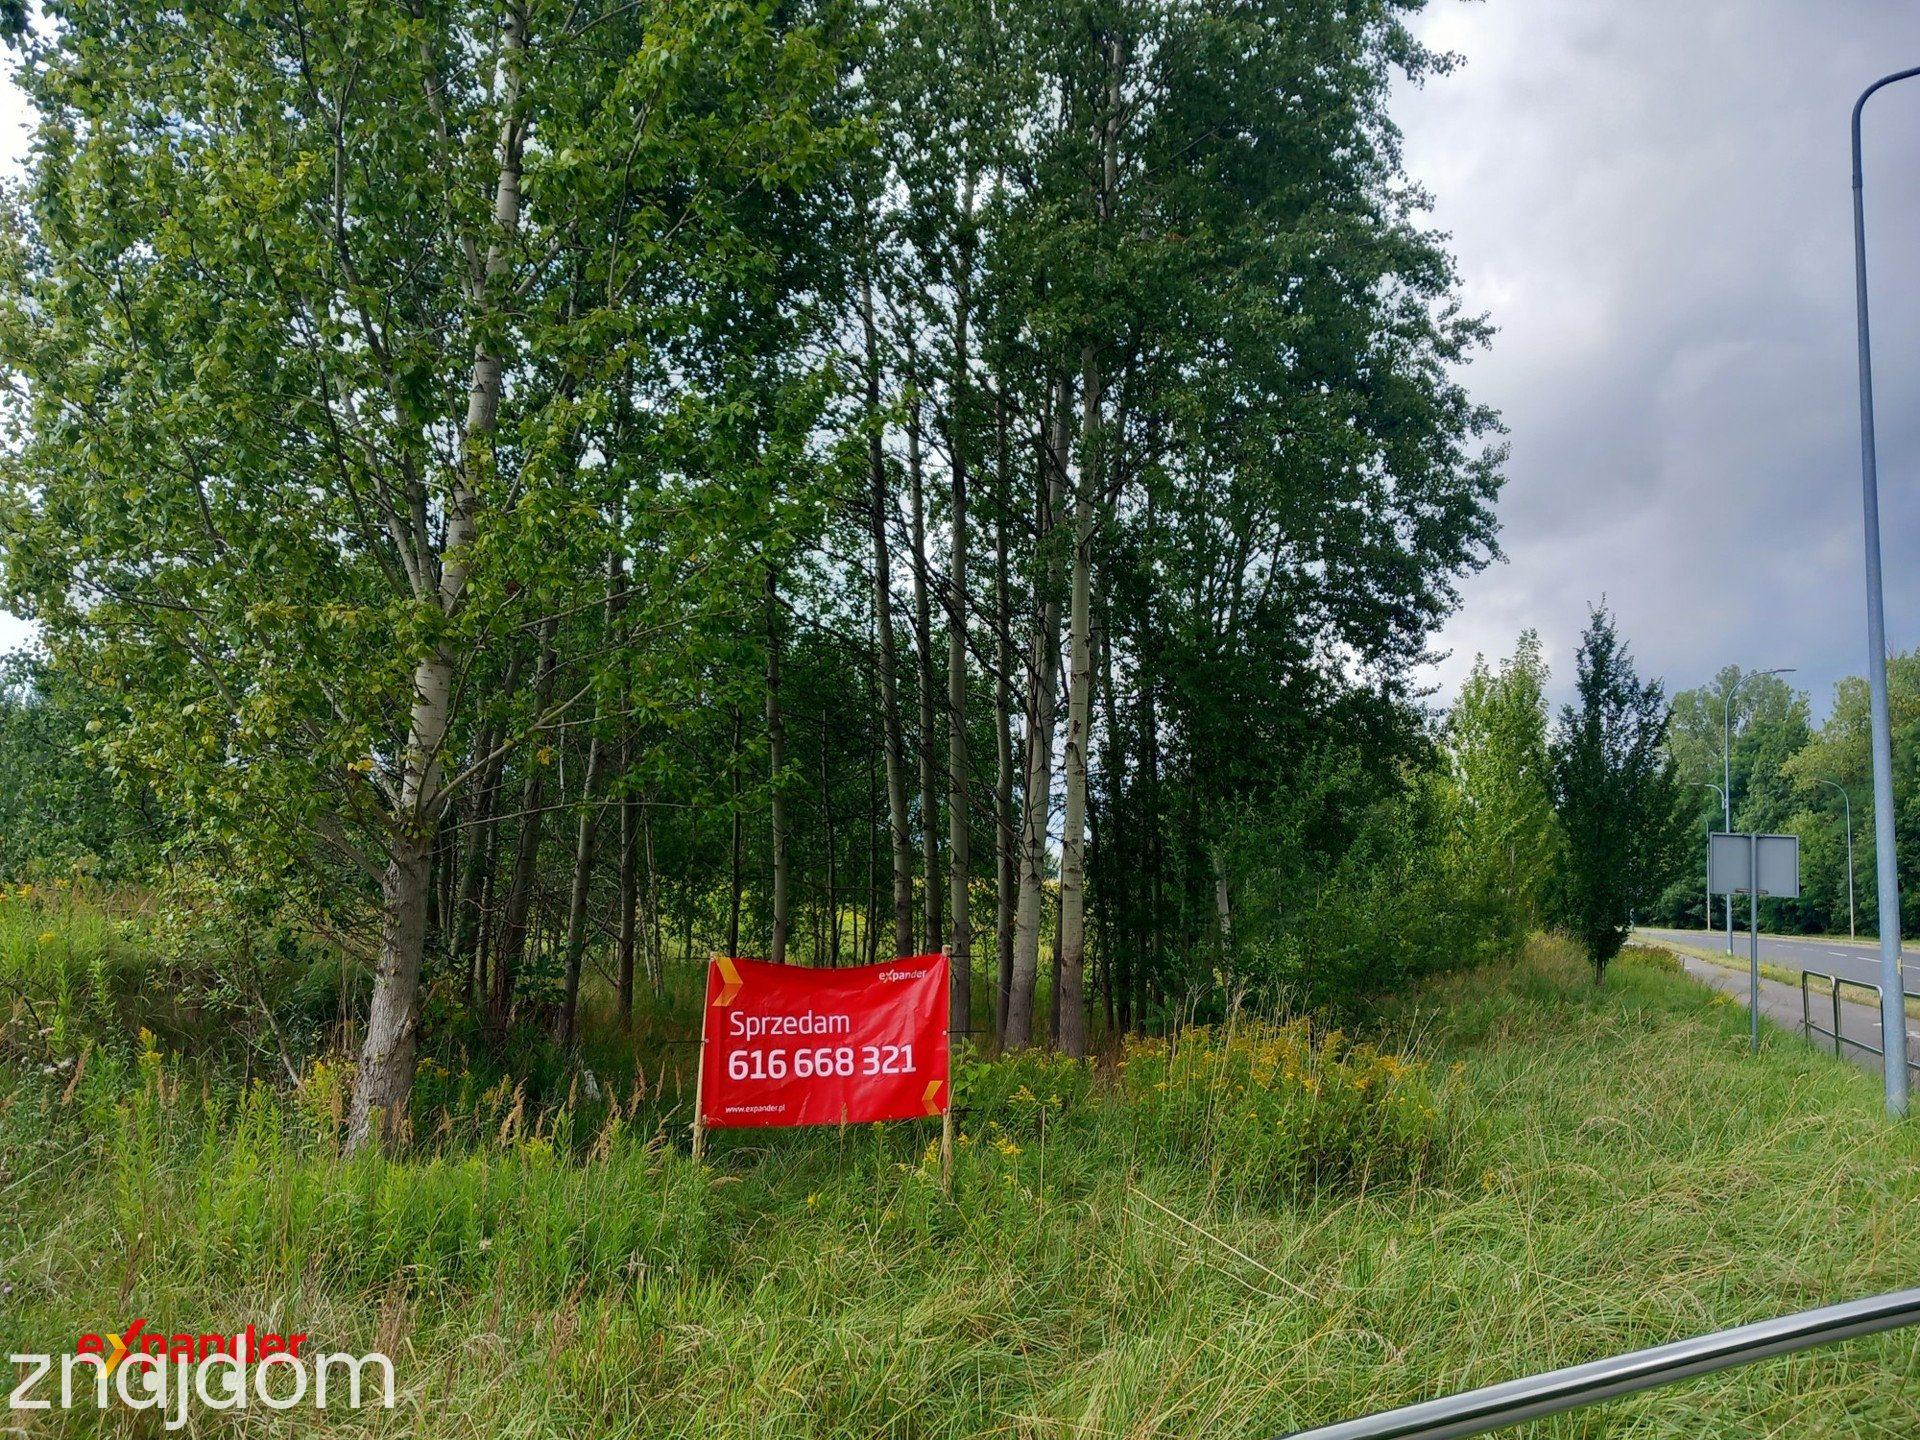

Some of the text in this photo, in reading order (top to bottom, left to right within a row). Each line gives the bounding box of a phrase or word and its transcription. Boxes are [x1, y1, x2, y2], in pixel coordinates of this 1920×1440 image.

[878, 968, 927, 984] expander
[729, 1009, 850, 1041] Sprzedam
[728, 1044, 917, 1080] 616 668 321
[725, 1103, 786, 1114] www.expander.pl
